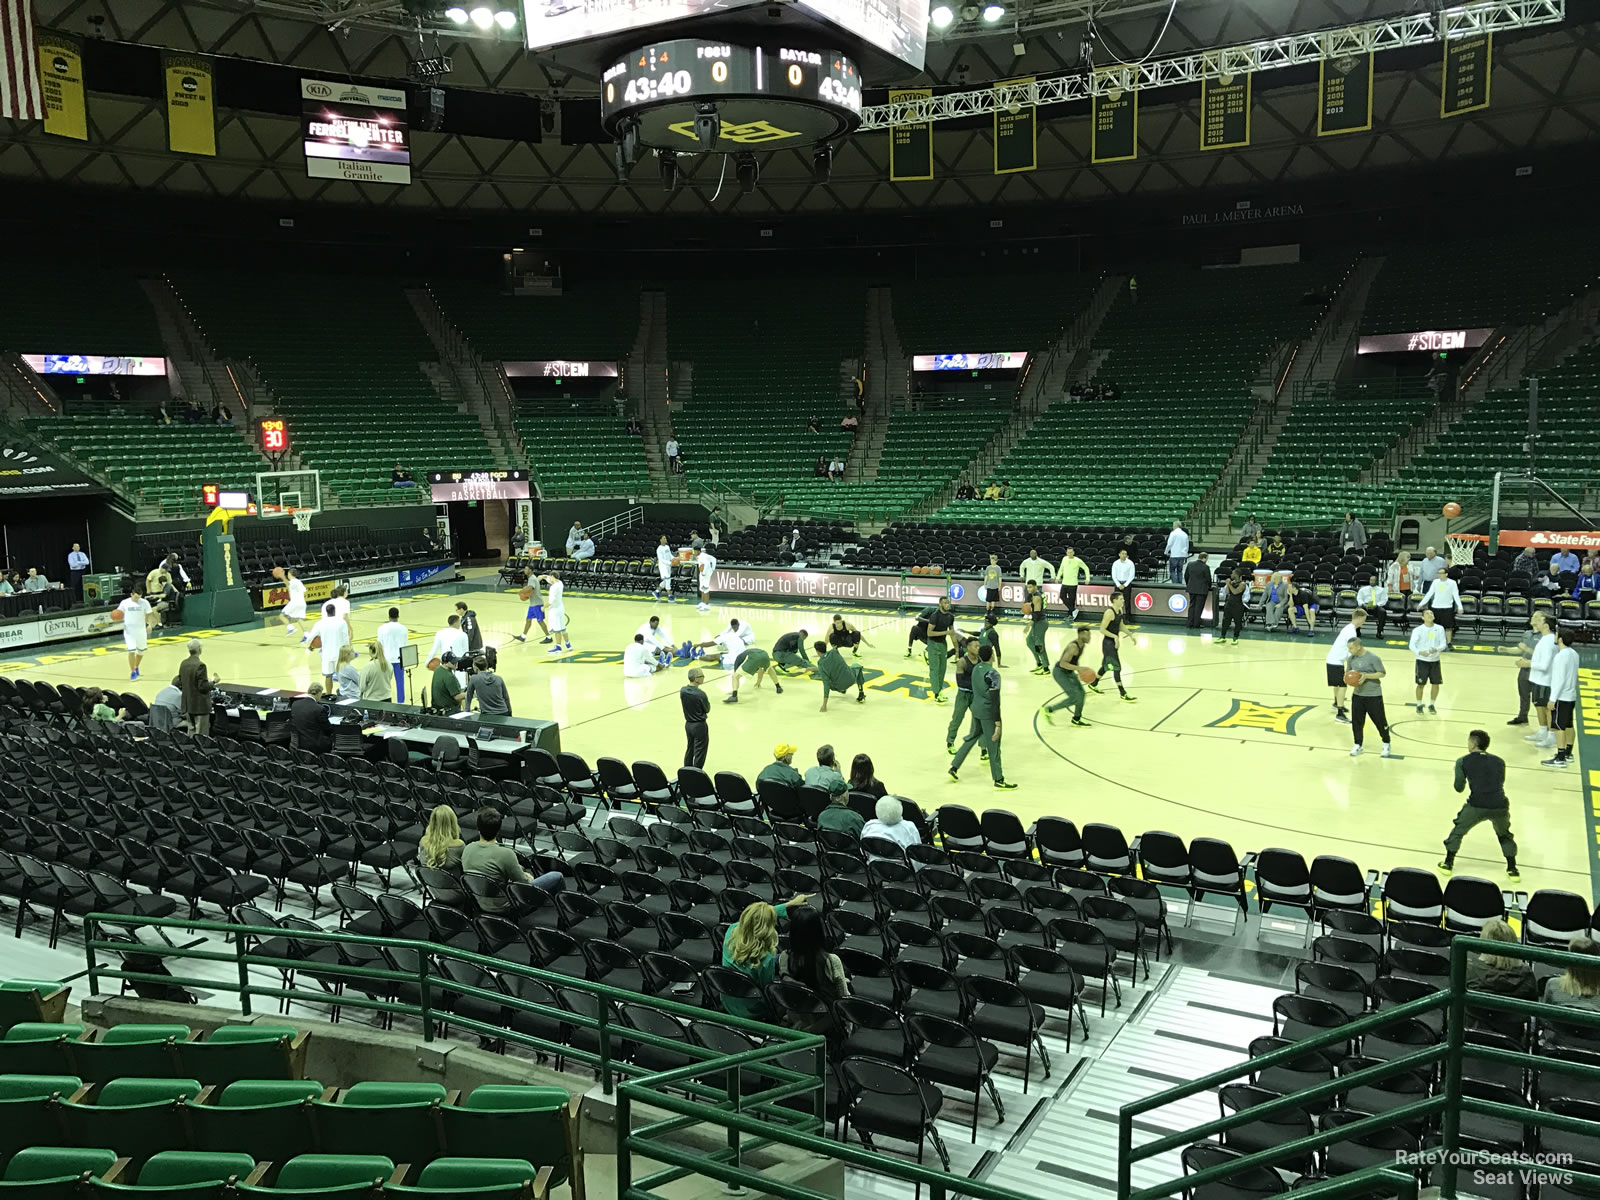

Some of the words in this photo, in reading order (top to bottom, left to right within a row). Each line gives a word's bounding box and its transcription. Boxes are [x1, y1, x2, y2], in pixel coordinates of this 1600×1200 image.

[779, 47, 822, 66] BAYLOR
[711, 61, 728, 82] 0
[788, 64, 803, 86] 0
[310, 86, 328, 95] KIA
[624, 69, 692, 103] 43:40
[1227, 92, 1244, 100] 2014
[1098, 110, 1114, 118] 2010
[1325, 106, 1344, 115] 2013
[1207, 129, 1224, 137] 2010
[1207, 136, 1224, 144] 2012
[338, 161, 372, 172] Italian
[343, 170, 383, 181] Granite
[1182, 213, 1208, 225] PAUL
[1222, 208, 1262, 222] MEYER
[1264, 204, 1304, 218] ARENA
[265, 430, 283, 448] 30
[435, 473, 441, 481] 0
[470, 472, 489, 480] 43:40
[513, 471, 520, 479] 0
[451, 489, 508, 501] BASKETBALL
[223, 542, 234, 586] BAYLOR
[716, 571, 774, 592] Welcome
[778, 576, 791, 593] to
[795, 576, 817, 595] the
[821, 576, 863, 598] Ferrell
[867, 578, 915, 600] Center
[44, 616, 84, 635] CENTRAL
